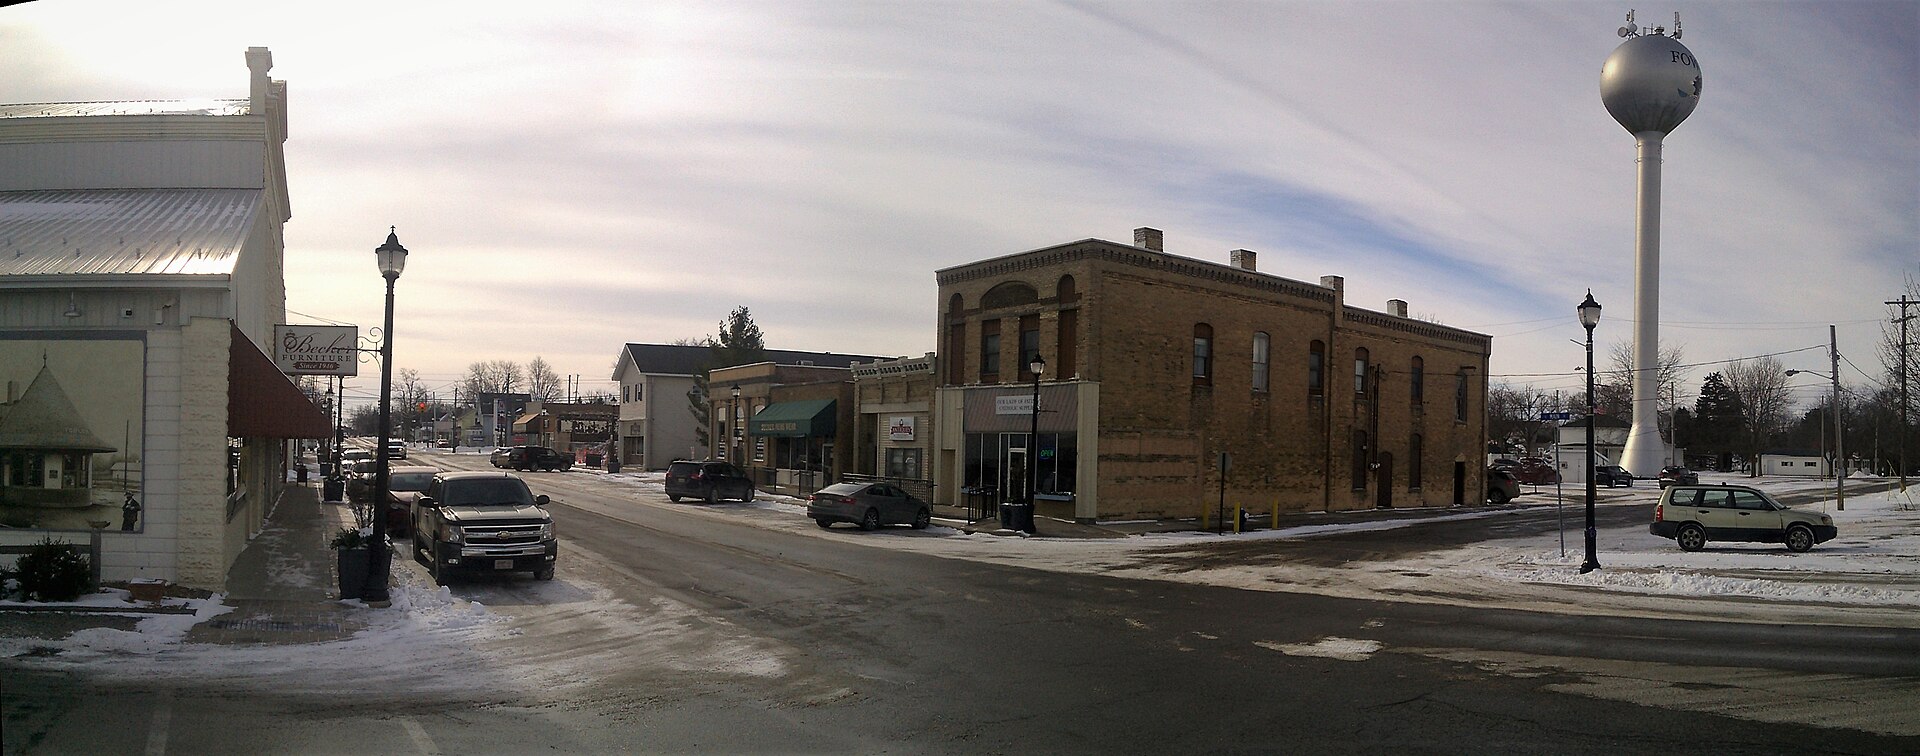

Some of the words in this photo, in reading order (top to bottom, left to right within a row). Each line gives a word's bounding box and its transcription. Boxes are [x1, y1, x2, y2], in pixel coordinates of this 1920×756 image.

[291, 333, 351, 354] Becker
[282, 354, 351, 362] FURNITURE
[1040, 449, 1054, 457] OPEN
